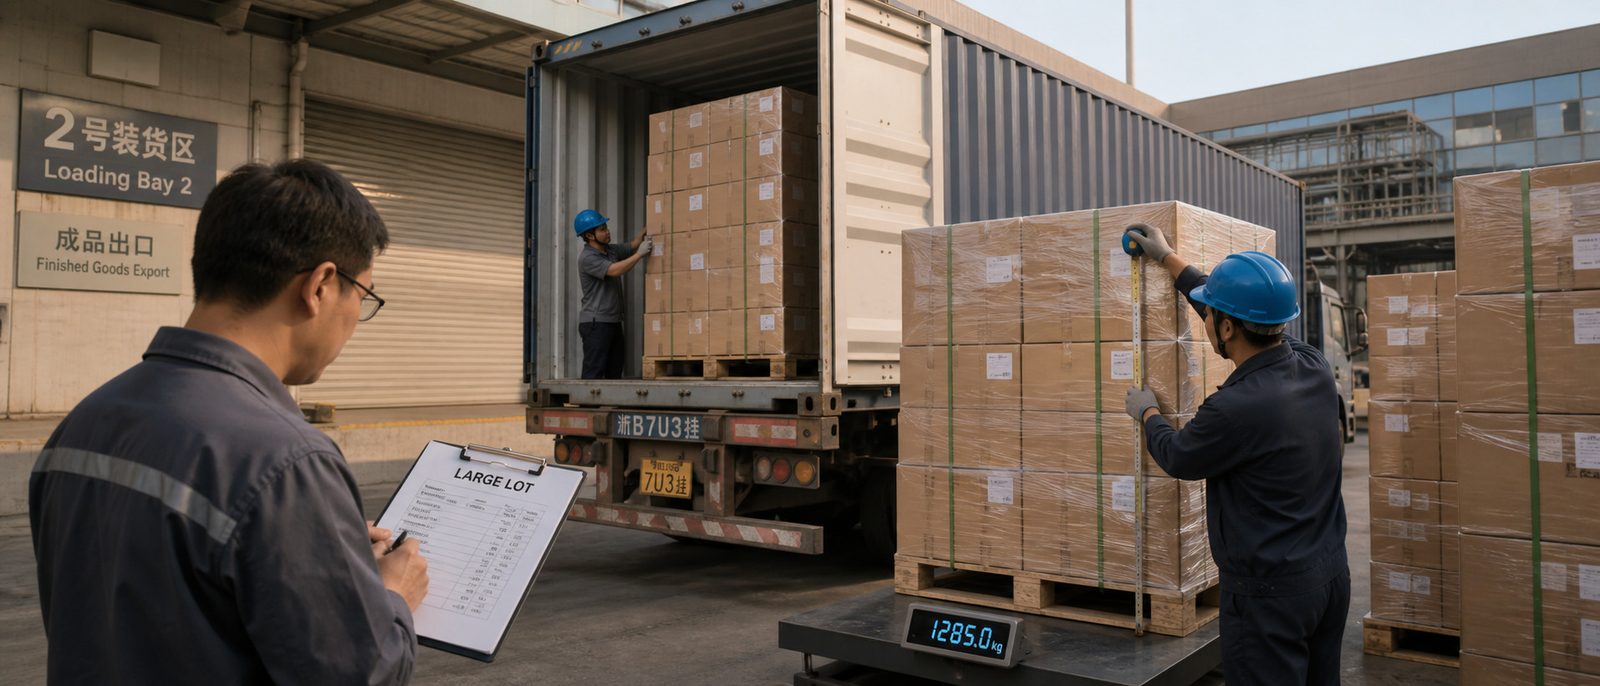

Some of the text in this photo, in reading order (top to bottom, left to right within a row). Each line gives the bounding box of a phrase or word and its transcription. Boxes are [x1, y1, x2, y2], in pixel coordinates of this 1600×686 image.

[44, 107, 195, 164] 2号装货区
[44, 159, 192, 195] Loading Bay 2
[56, 227, 153, 257] 成品出口
[36, 257, 170, 280] Finished Goods Export
[454, 467, 535, 494] LARGE LOT
[931, 620, 1003, 654] 1285.0 kg
